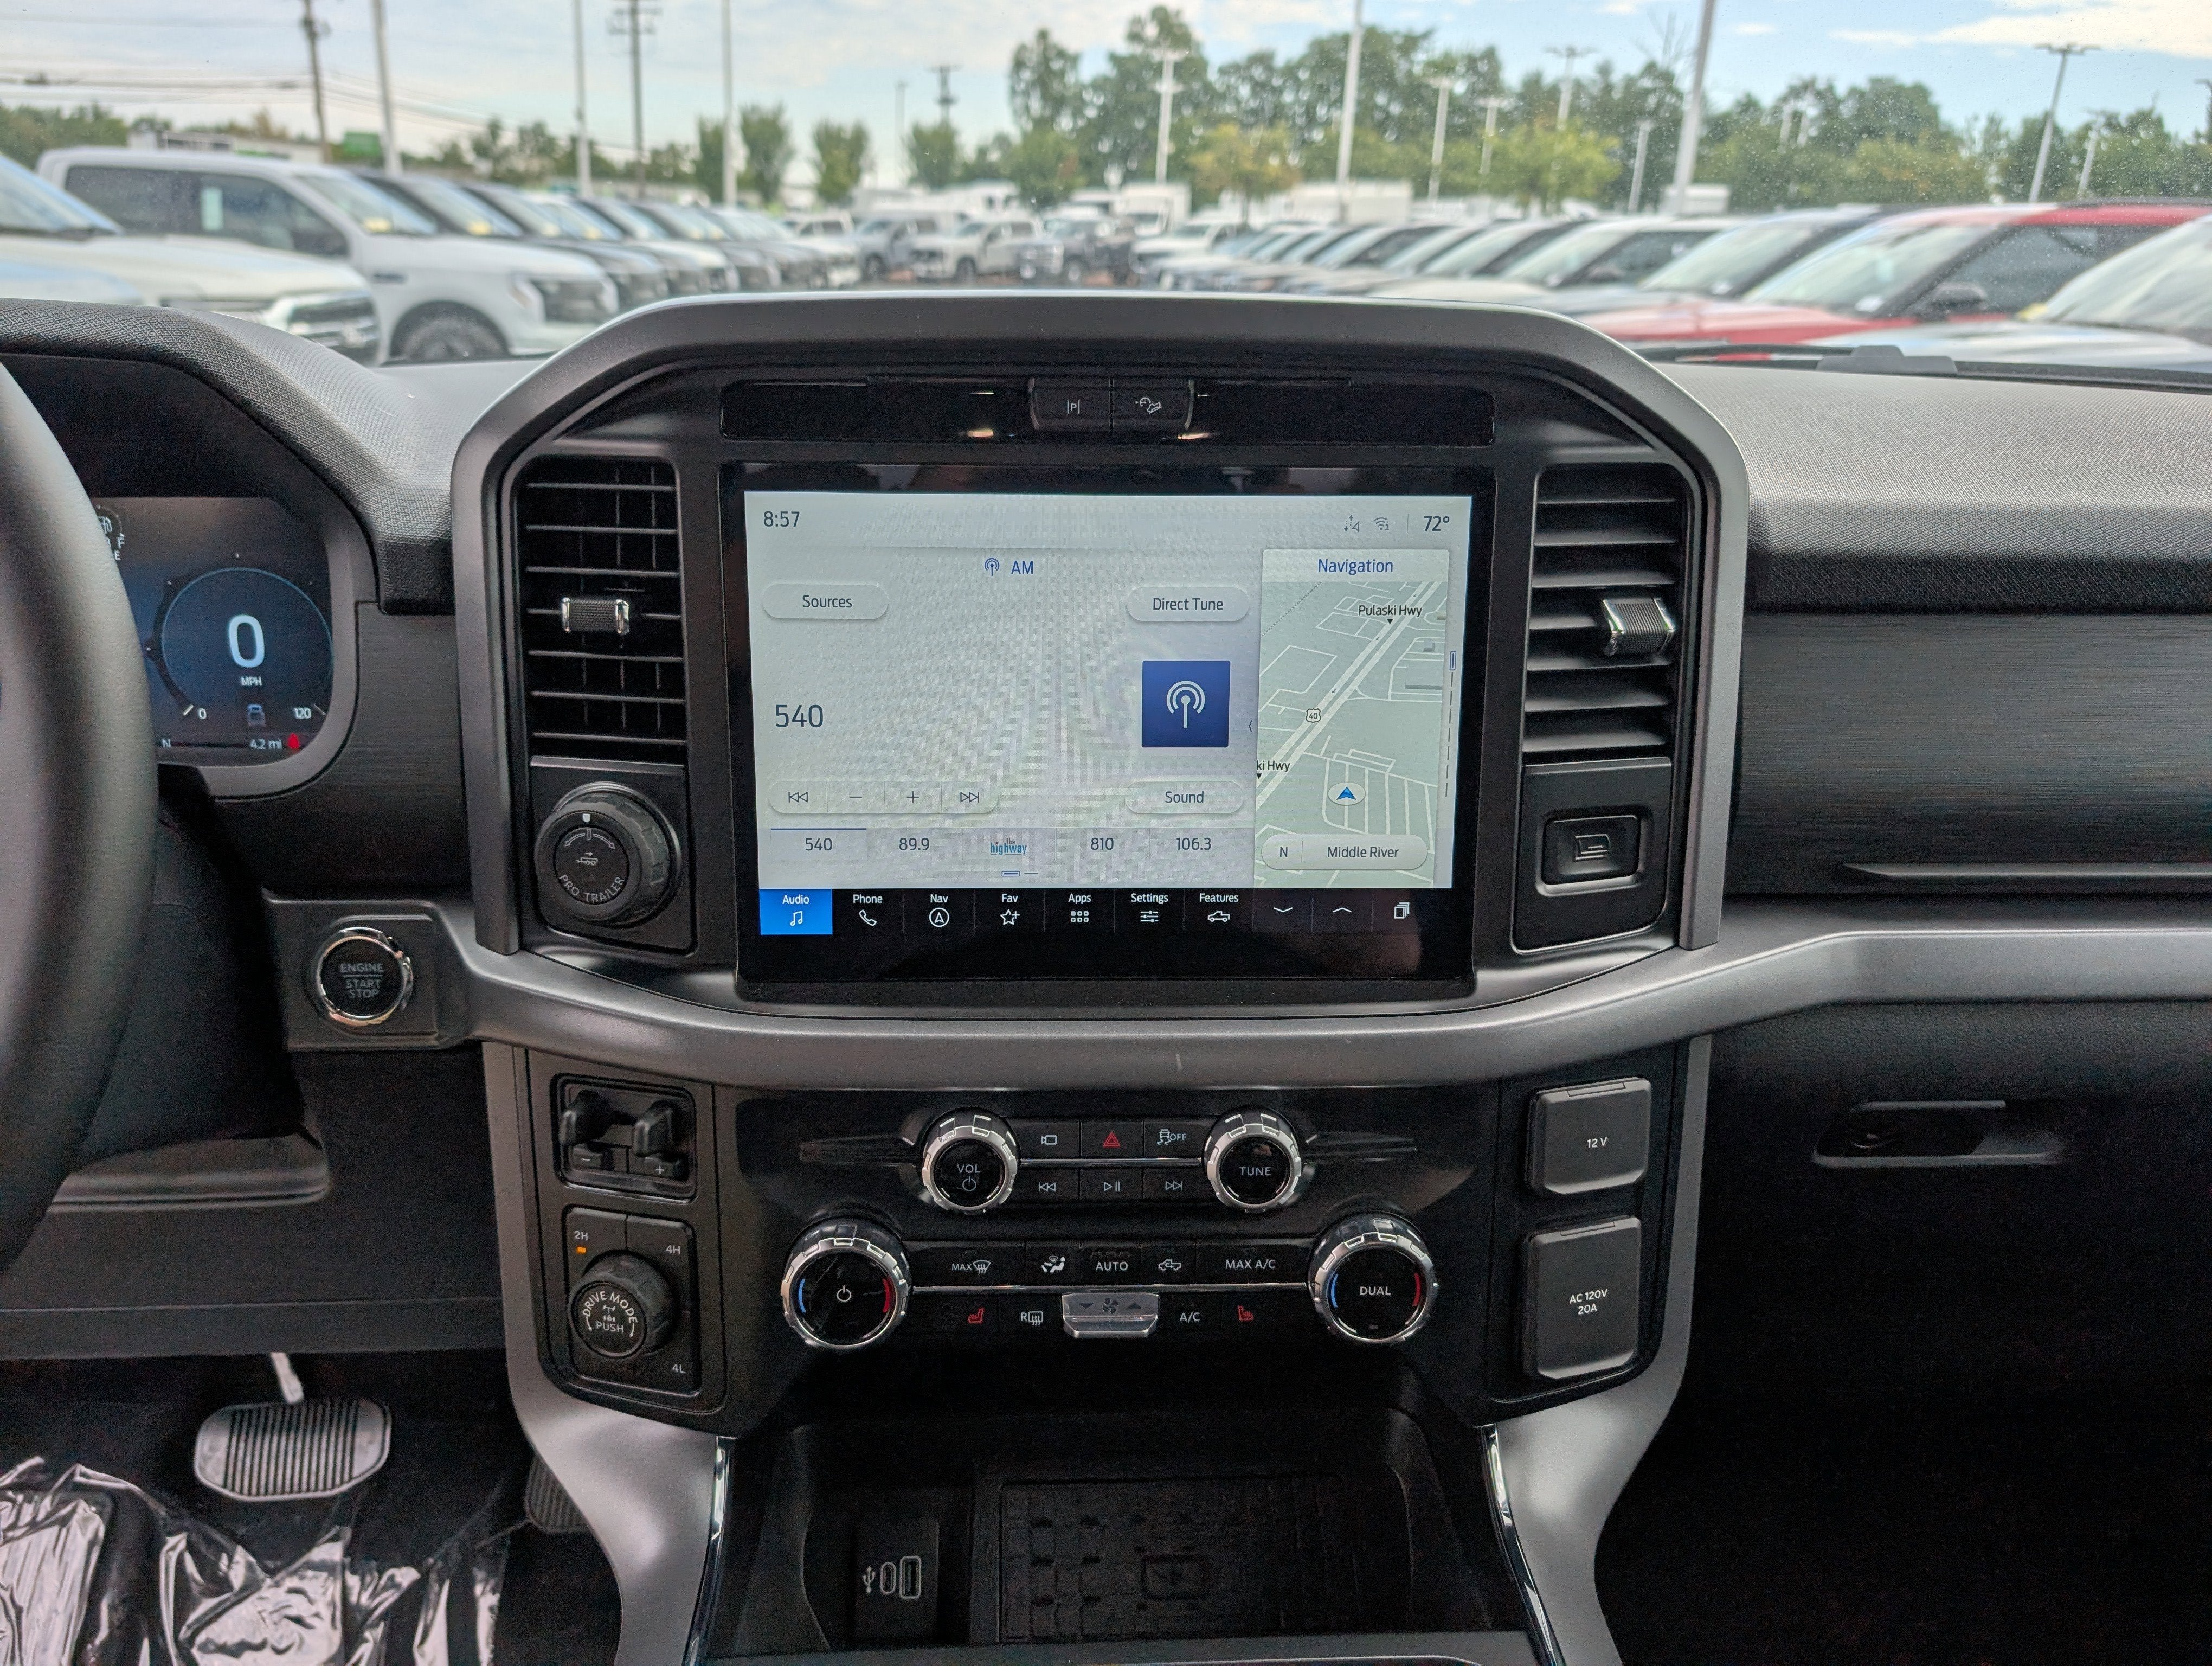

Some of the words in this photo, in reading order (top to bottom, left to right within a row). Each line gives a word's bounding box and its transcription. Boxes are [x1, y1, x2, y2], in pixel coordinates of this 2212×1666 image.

[763, 511, 800, 527] 8:57
[1423, 516, 1449, 531] 72°
[1011, 561, 1033, 574] AM
[1318, 559, 1393, 574] Navigation
[802, 595, 852, 607] Sources
[1153, 598, 1188, 610] Direct
[1193, 598, 1223, 610] Tune
[1358, 605, 1396, 616] Pulaski
[1399, 606, 1422, 617] Hwy
[228, 614, 265, 667] 0
[241, 677, 262, 686] MPH
[198, 708, 207, 719] 0
[294, 707, 312, 719] 120
[775, 705, 823, 727] 540
[162, 739, 171, 748] N
[1267, 761, 1290, 772] Hwy
[1165, 791, 1204, 803] Sound
[805, 838, 832, 851] 540
[899, 838, 929, 851] 89.9
[991, 842, 1026, 855] highway
[1090, 838, 1114, 850] 810
[1176, 838, 1211, 850] 106.3
[1279, 848, 1288, 857] N
[1327, 847, 1366, 857] Middle
[1369, 847, 1399, 857] River
[559, 874, 580, 895] PRO
[584, 876, 625, 902] TRAILER
[782, 894, 809, 904] Audio
[853, 894, 882, 903] Phone
[930, 894, 948, 902] Nav
[1002, 894, 1017, 902] Fav
[1069, 894, 1090, 905] Apps
[1131, 893, 1168, 904] Settings
[1200, 893, 1238, 902] Features
[340, 963, 384, 972] ENGINE
[346, 979, 380, 988] START
[349, 989, 380, 998] STOP
[1587, 1139, 1598, 1148] 12
[957, 1164, 980, 1172] VOL
[1239, 1167, 1271, 1176] TUNE
[574, 1231, 588, 1240] 2H
[666, 1245, 680, 1254] 4H
[1096, 1261, 1128, 1271] AUTO
[1225, 1260, 1251, 1269] MAX
[1255, 1259, 1276, 1269] A/C
[1360, 1286, 1391, 1295] DUAL
[1569, 1293, 1583, 1304] AC
[1584, 1289, 1608, 1302] 120V
[582, 1291, 607, 1317] DRIVE
[609, 1292, 638, 1323] MODE
[1578, 1304, 1597, 1315] 20A
[1179, 1312, 1200, 1322] A/C
[596, 1321, 624, 1333] PUSH
[672, 1363, 685, 1373] 4L
